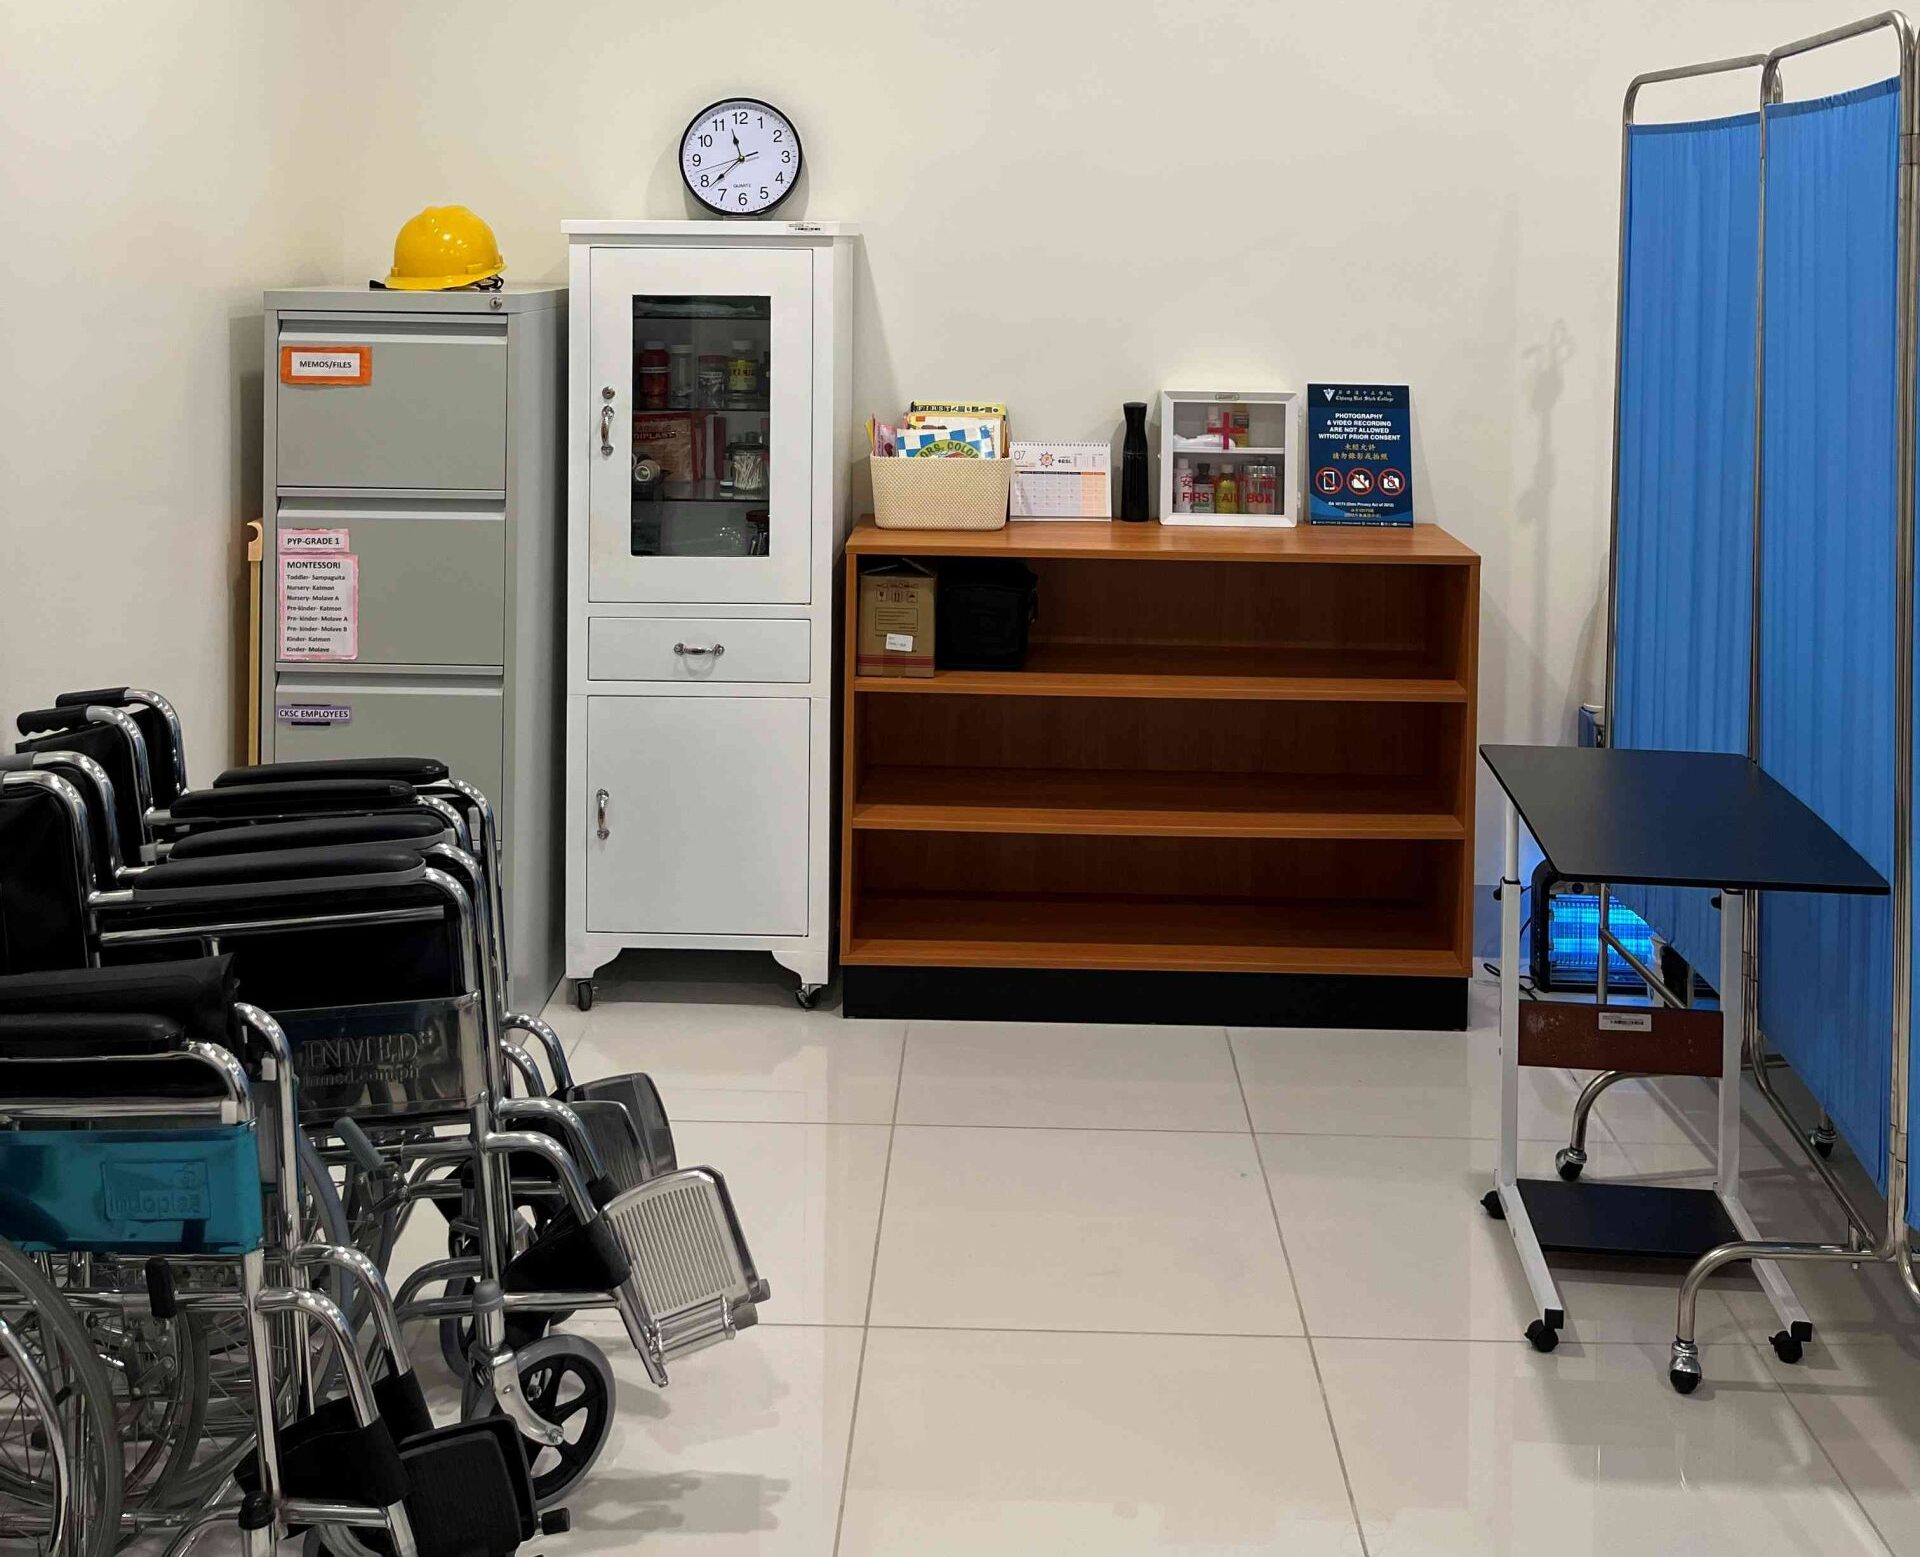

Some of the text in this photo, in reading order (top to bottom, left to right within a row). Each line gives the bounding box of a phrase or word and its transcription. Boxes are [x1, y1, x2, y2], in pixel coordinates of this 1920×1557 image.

[732, 112, 748, 124] 12
[757, 116, 763, 129] 1
[713, 119, 725, 131] 11
[698, 135, 712, 147] 10
[773, 130, 782, 142] 2
[692, 154, 701, 166] 9
[781, 151, 791, 163] 3
[701, 175, 709, 187] 8
[775, 172, 784, 184] 4
[718, 189, 727, 201] 7
[739, 193, 747, 205] 6
[760, 187, 769, 199] 5
[299, 360, 352, 369] MEMOS/FILES
[1014, 450, 1026, 460] 07
[1182, 492, 1214, 503] FIRST
[1246, 492, 1272, 503] BOX
[286, 561, 341, 569] MONTESSORI
[279, 709, 348, 718] CKSC EMPLOYEES
